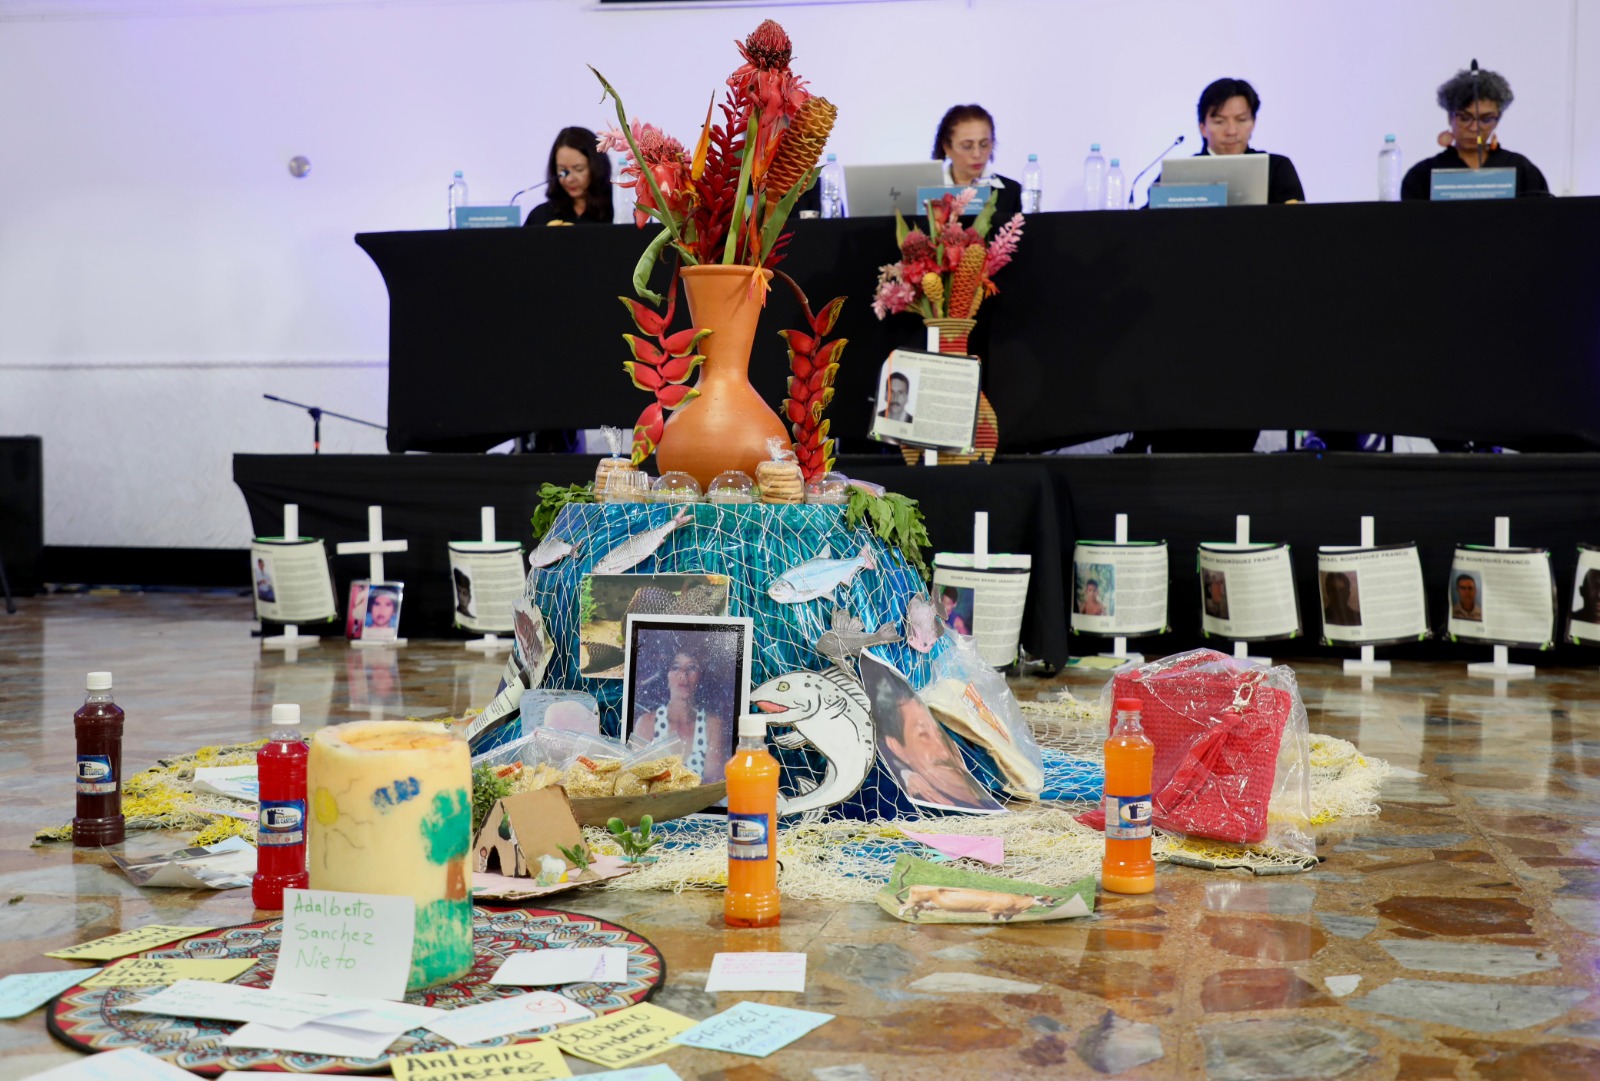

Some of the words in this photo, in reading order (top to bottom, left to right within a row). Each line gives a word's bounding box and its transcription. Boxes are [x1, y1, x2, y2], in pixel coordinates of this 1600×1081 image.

[294, 893, 375, 919] Adalberto
[294, 922, 376, 945] Sanchez
[295, 943, 357, 969] Nieto
[406, 1050, 533, 1072] Antonio
